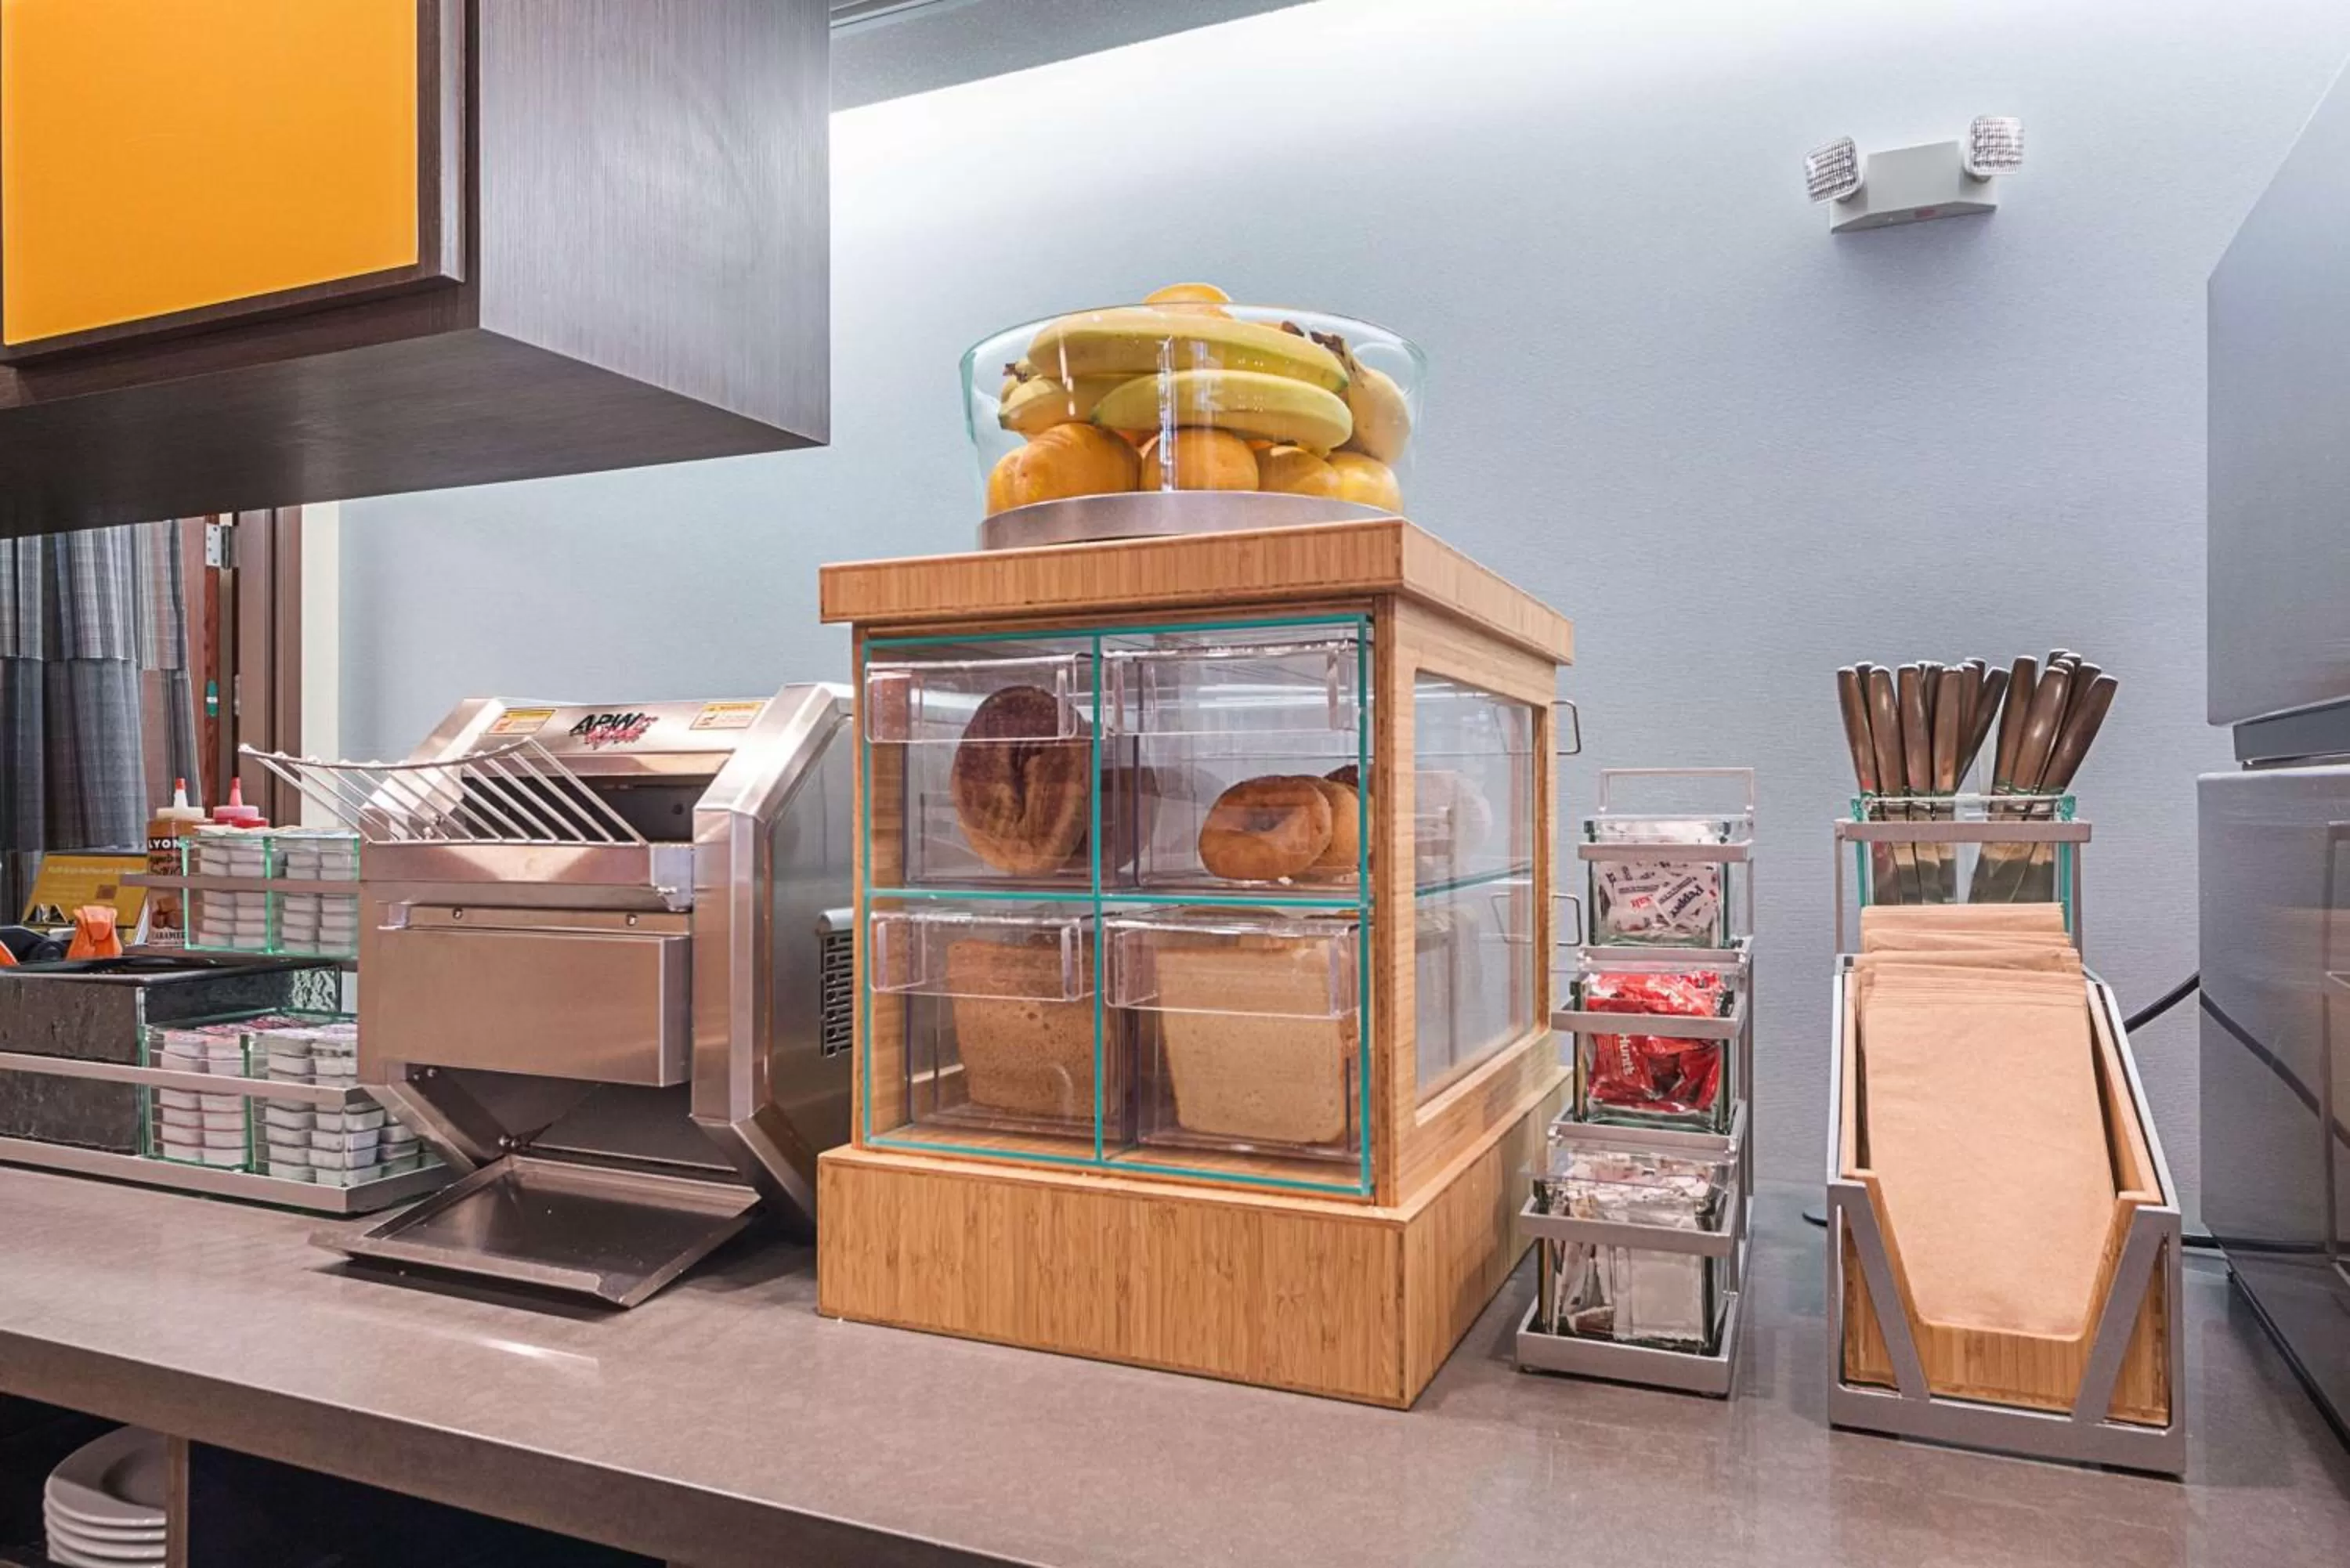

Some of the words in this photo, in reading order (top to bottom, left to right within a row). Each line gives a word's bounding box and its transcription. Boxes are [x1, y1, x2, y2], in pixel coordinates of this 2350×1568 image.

[569, 712, 644, 736] APW
[149, 839, 189, 849] LYON
[1670, 884, 1705, 918] Pepper
